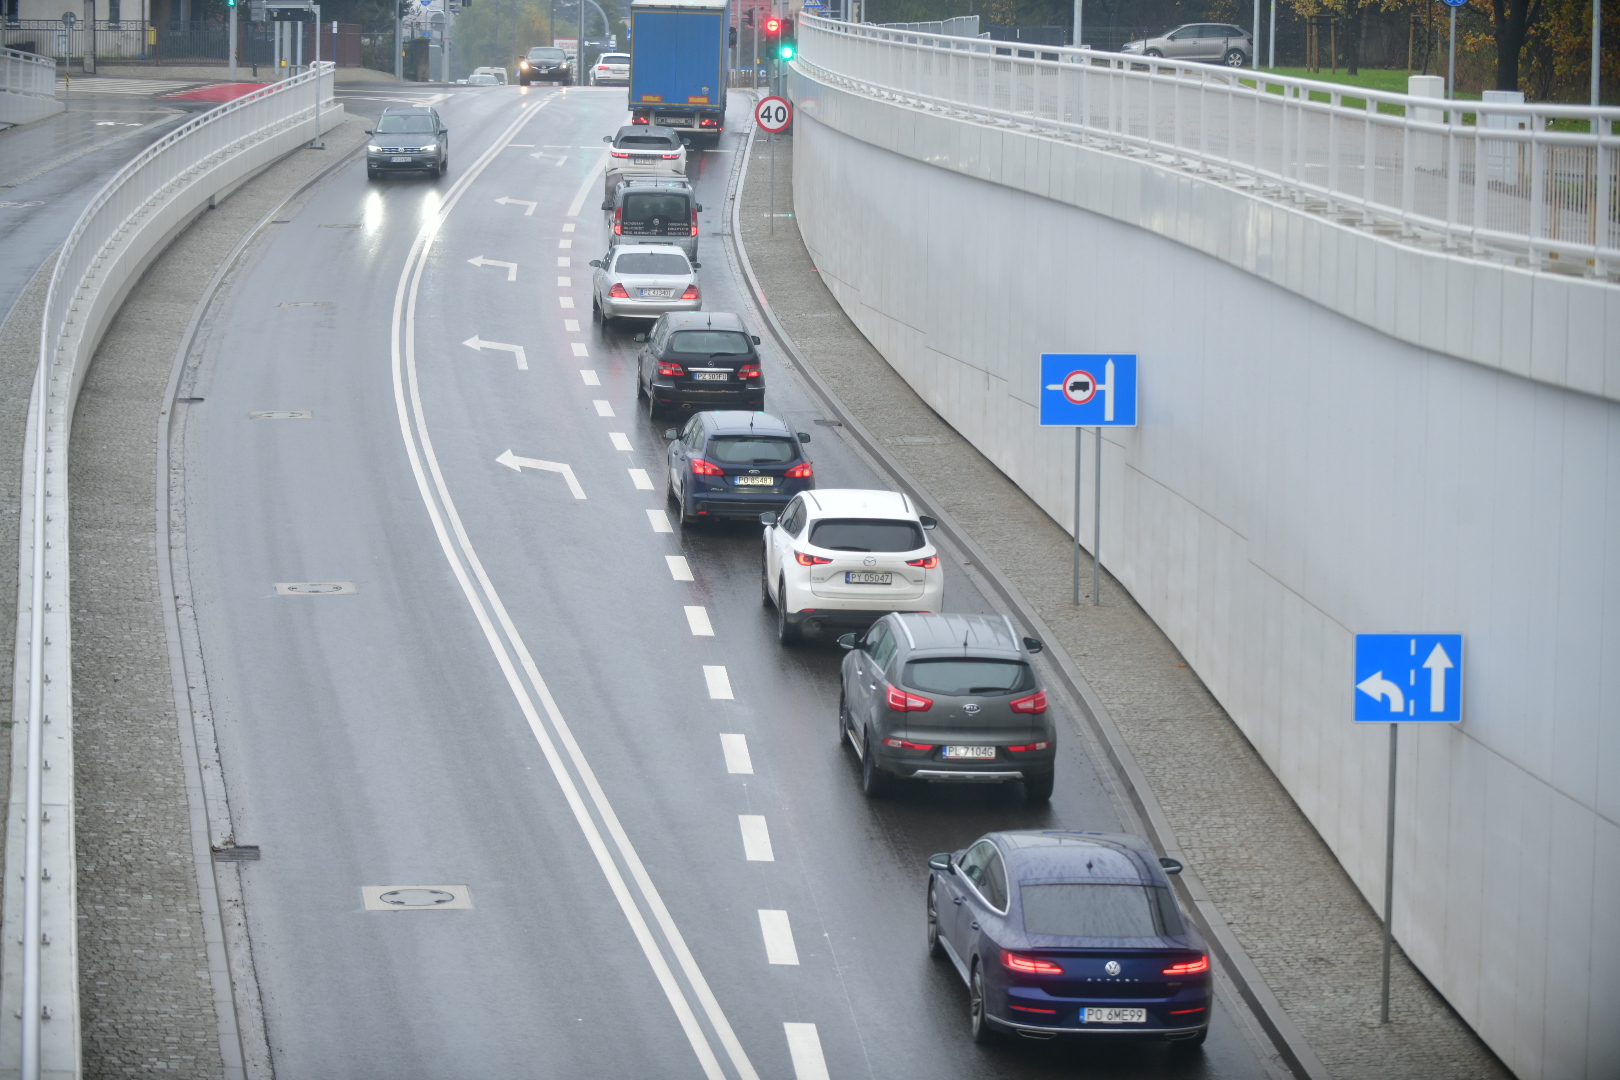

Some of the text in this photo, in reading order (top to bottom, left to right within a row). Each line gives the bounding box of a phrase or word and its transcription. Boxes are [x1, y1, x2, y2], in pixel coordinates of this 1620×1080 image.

[760, 105, 787, 123] 40
[738, 476, 749, 484] PO
[851, 574, 890, 583] PY 05047
[948, 746, 993, 757] PL 7104G
[1087, 1008, 1143, 1021] PO 6ME99
